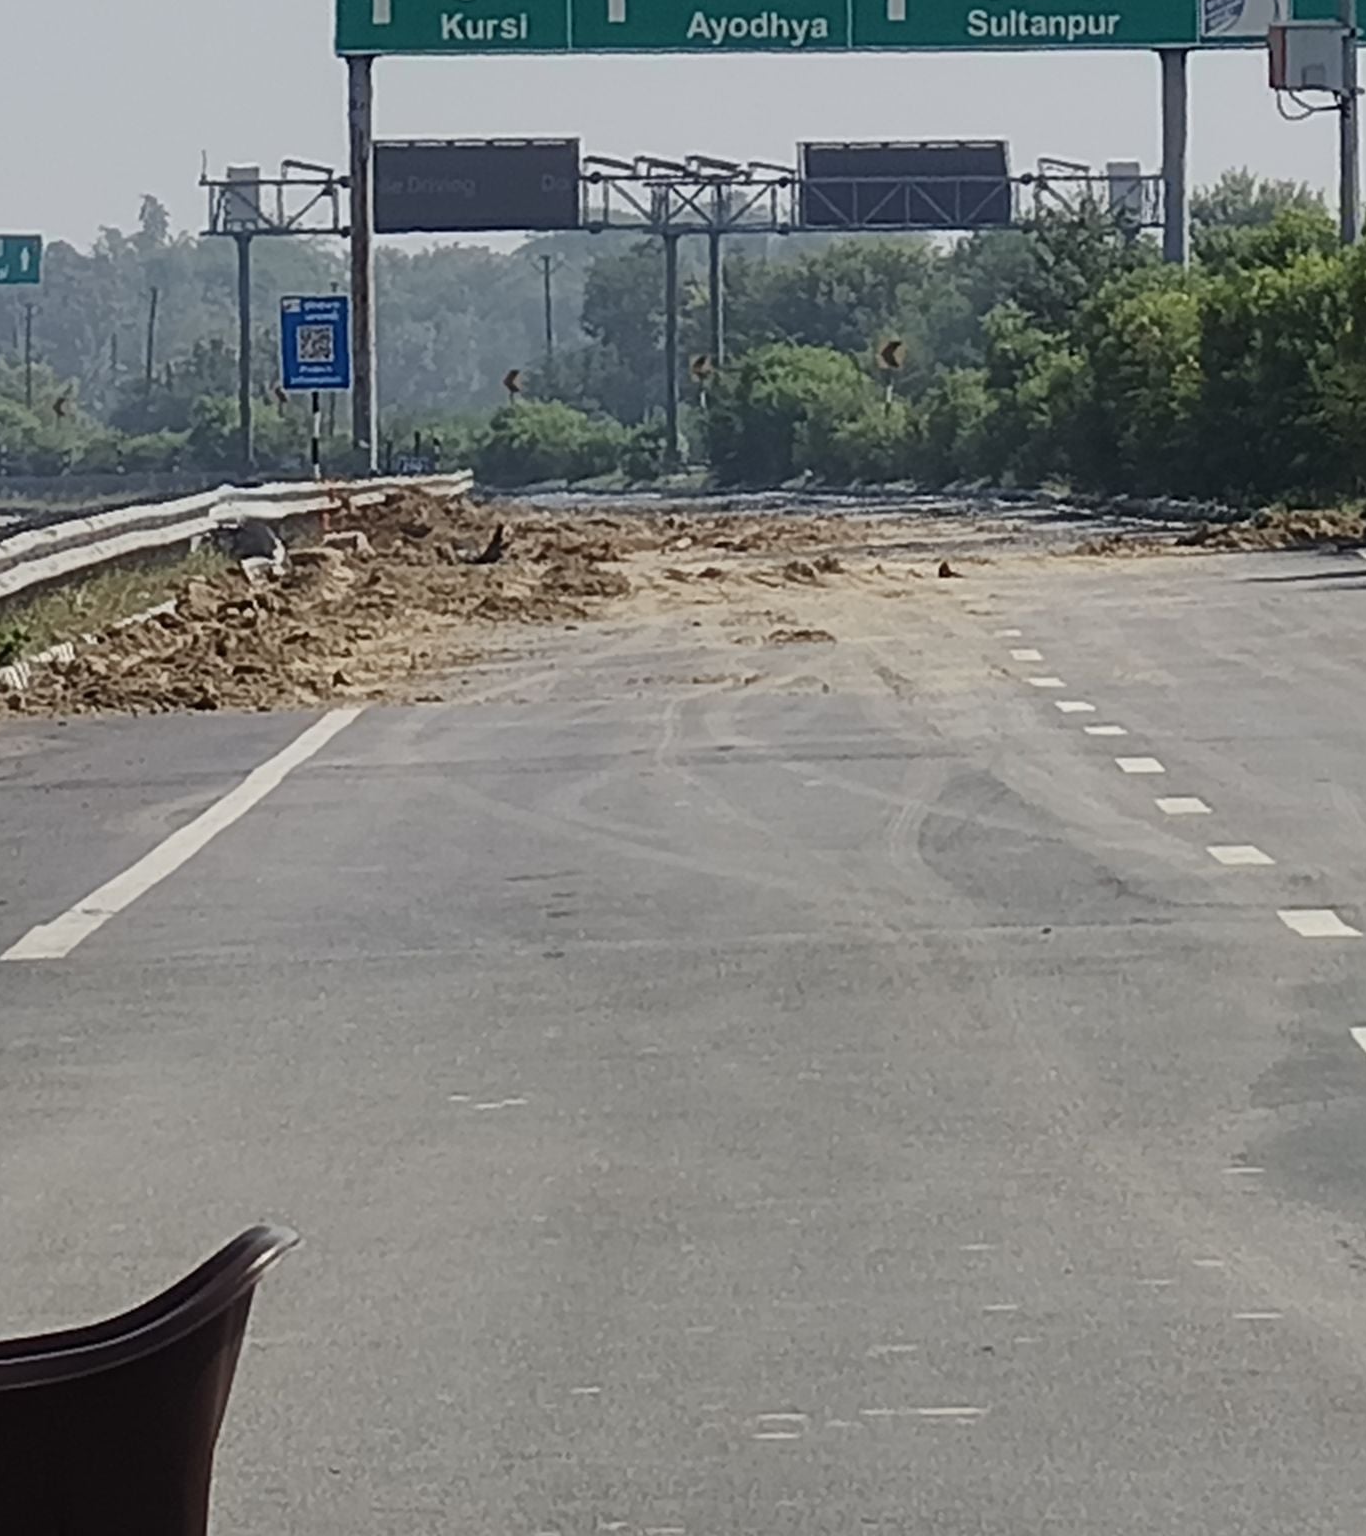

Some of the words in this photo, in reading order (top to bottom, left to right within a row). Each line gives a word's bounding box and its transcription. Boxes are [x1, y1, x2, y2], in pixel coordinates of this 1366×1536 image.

[440, 12, 528, 41] Kursi
[686, 11, 829, 45] Ayodhya
[967, 9, 1120, 43] Sultanpur
